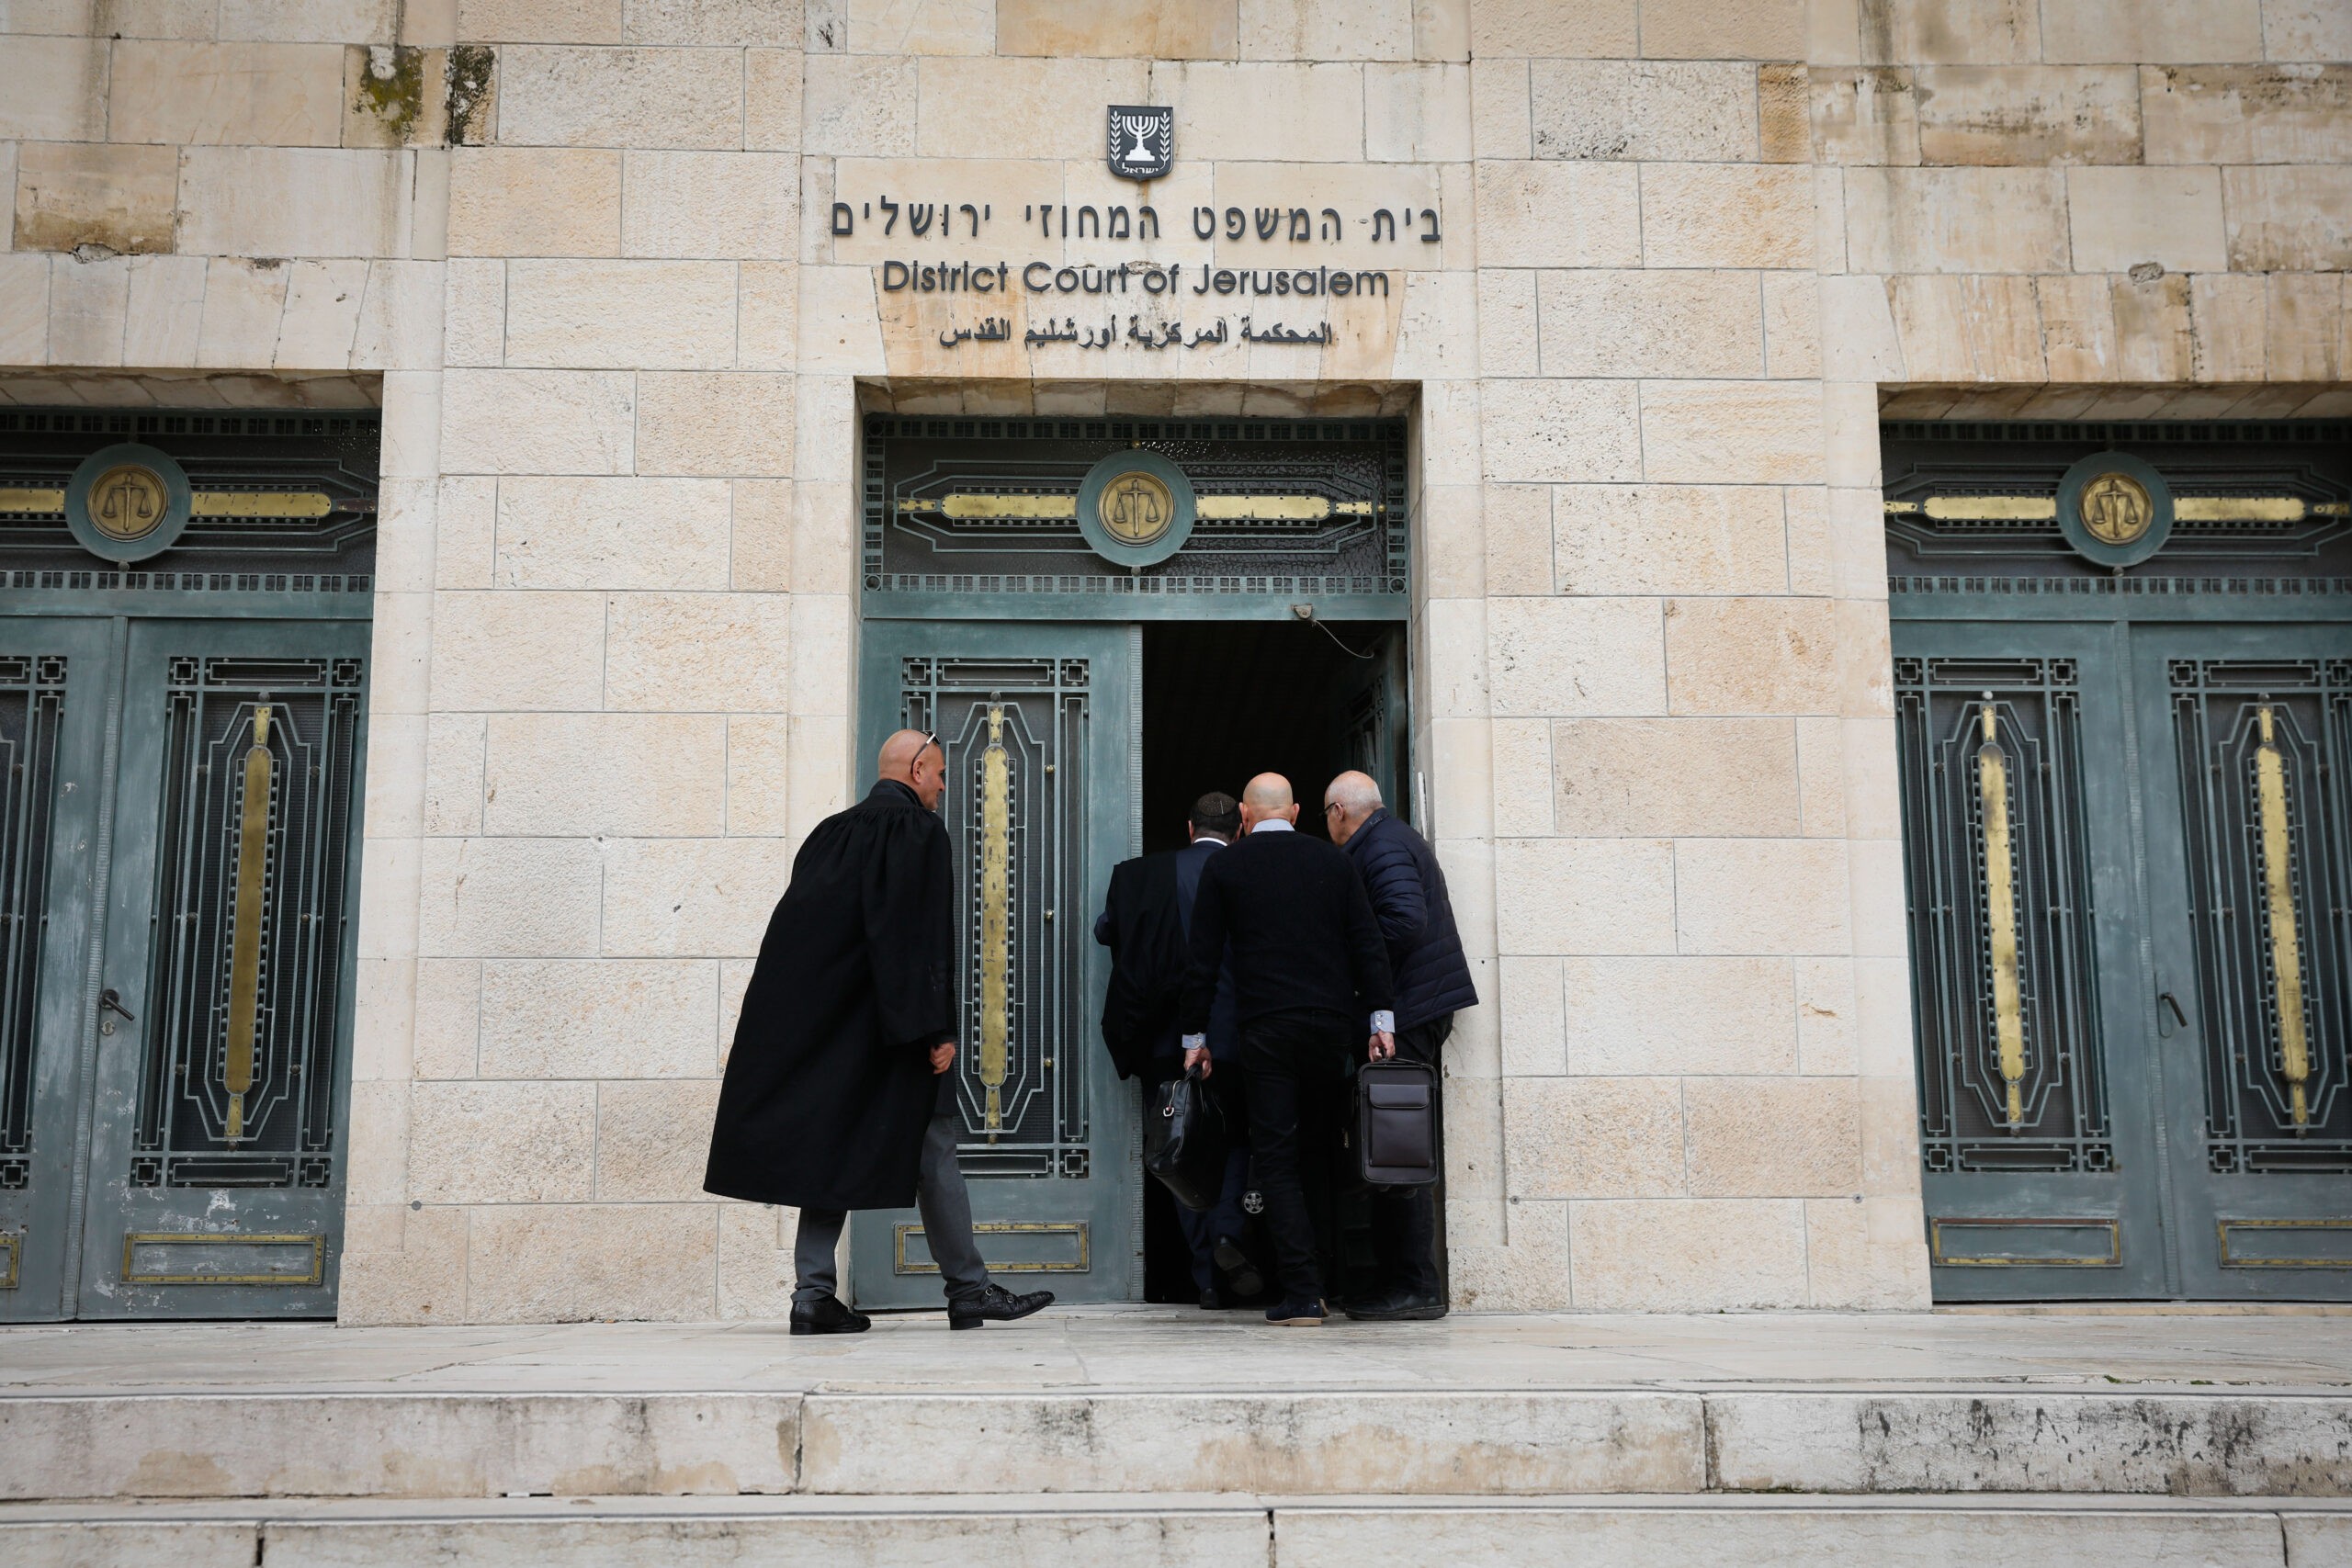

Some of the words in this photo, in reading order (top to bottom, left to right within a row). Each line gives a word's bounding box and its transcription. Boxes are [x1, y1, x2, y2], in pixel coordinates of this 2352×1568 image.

[1121, 162, 1159, 175] ישראל
[831, 195, 990, 237] ירושלים
[1024, 204, 1159, 239] המחוזי
[1193, 207, 1341, 241] המשפט
[1371, 209, 1441, 242] בית
[883, 260, 1008, 292] District
[1023, 262, 1129, 293] Court
[1143, 263, 1180, 295] of
[1193, 265, 1389, 297] Jerusalem
[939, 316, 1011, 348] القدس
[1023, 315, 1116, 350] أورشليم
[1127, 315, 1228, 349] المركزية
[1240, 316, 1332, 344] المحكمة
